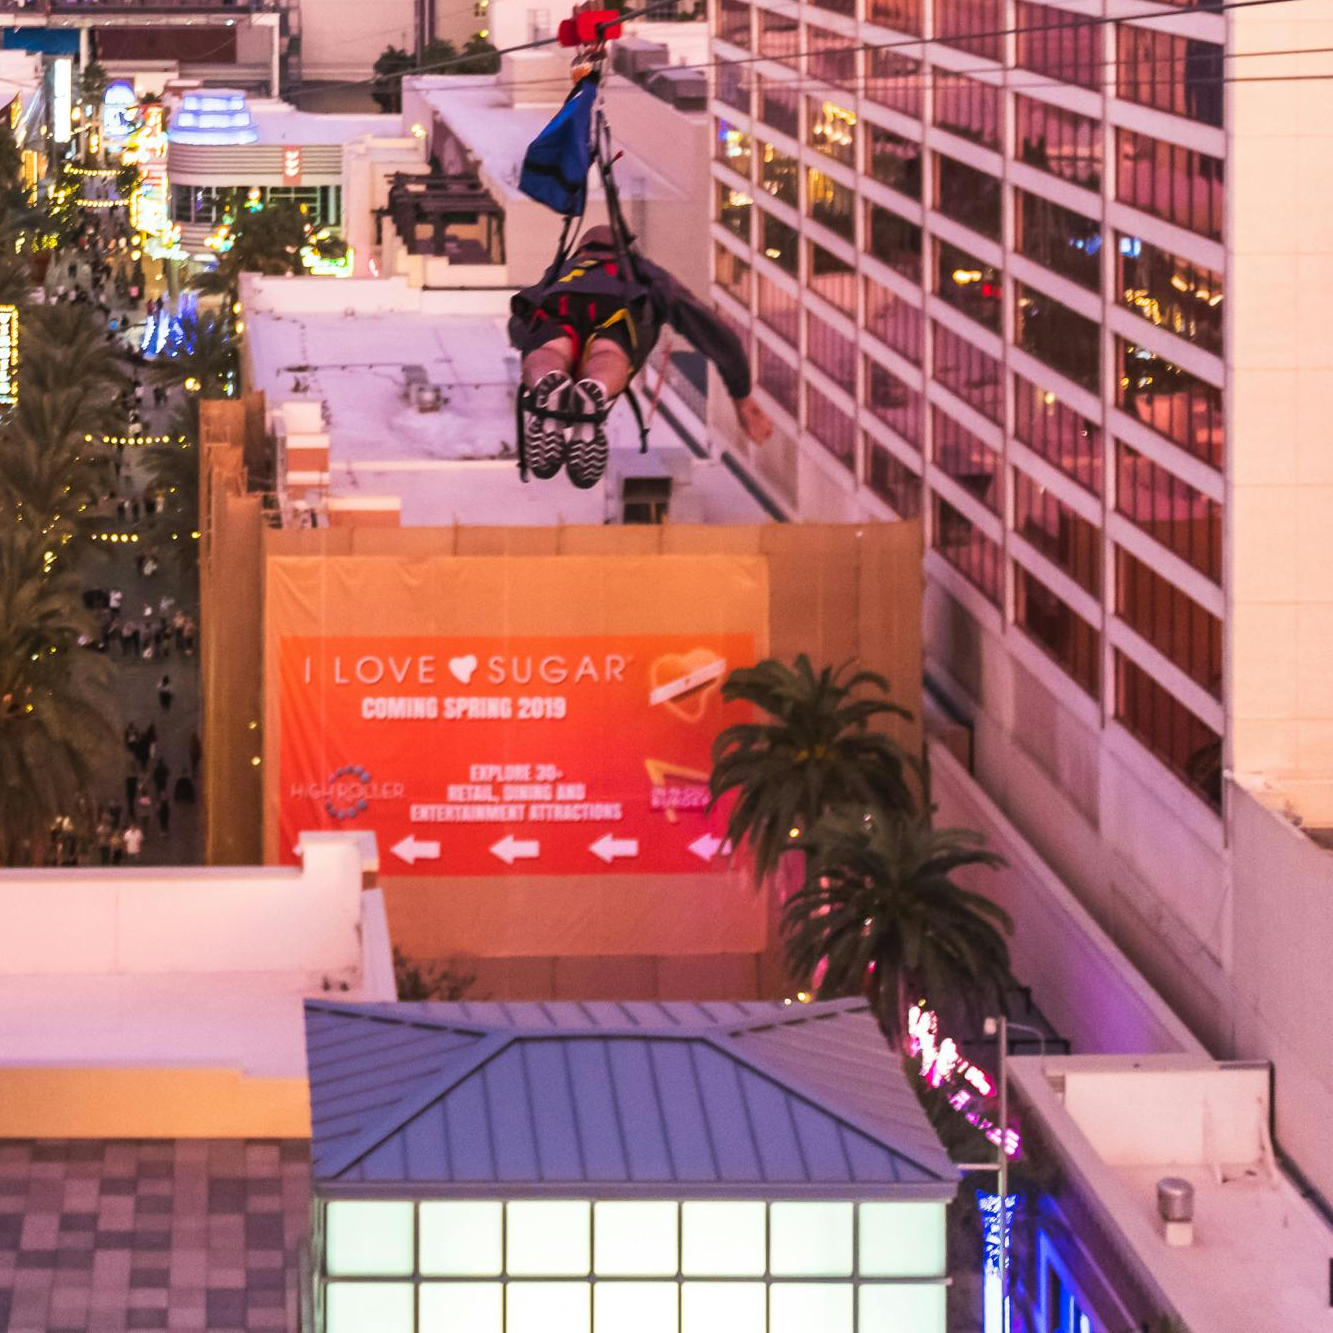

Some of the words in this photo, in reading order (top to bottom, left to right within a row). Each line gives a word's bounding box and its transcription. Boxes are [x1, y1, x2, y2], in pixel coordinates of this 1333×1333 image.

[304, 657, 311, 684] I
[334, 655, 436, 685] LOVE
[487, 654, 627, 685] SUGAR
[361, 696, 438, 720] COMING
[443, 696, 513, 720] SPRING
[516, 696, 567, 720] 2019
[469, 763, 532, 783] EXPLORE
[446, 783, 500, 803] RETAIL,
[503, 783, 553, 802] DINING
[556, 783, 587, 802] AND
[409, 803, 526, 823] ENTERTAINMENT
[528, 802, 623, 822] ATTRACTIONS
